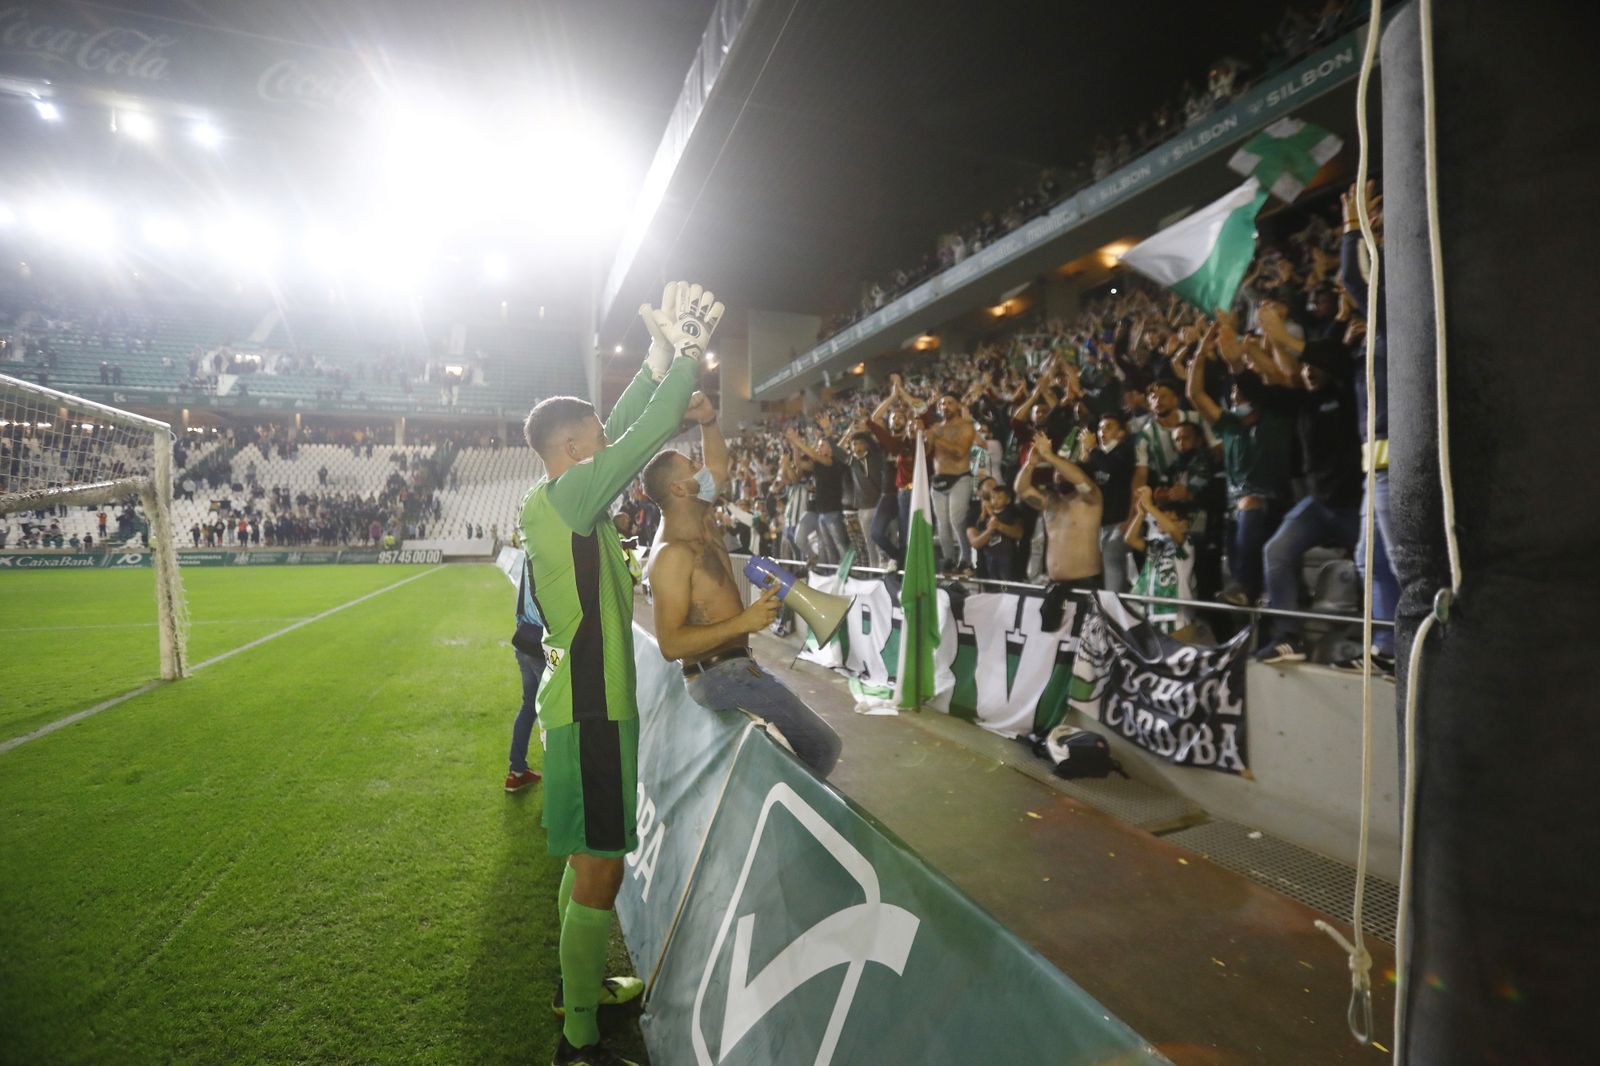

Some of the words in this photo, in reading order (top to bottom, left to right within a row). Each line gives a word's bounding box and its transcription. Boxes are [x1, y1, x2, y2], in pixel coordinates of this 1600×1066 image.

[1266, 48, 1353, 108] SILBON
[1172, 114, 1239, 161] SILBON
[16, 556, 95, 567] CaixaBank
